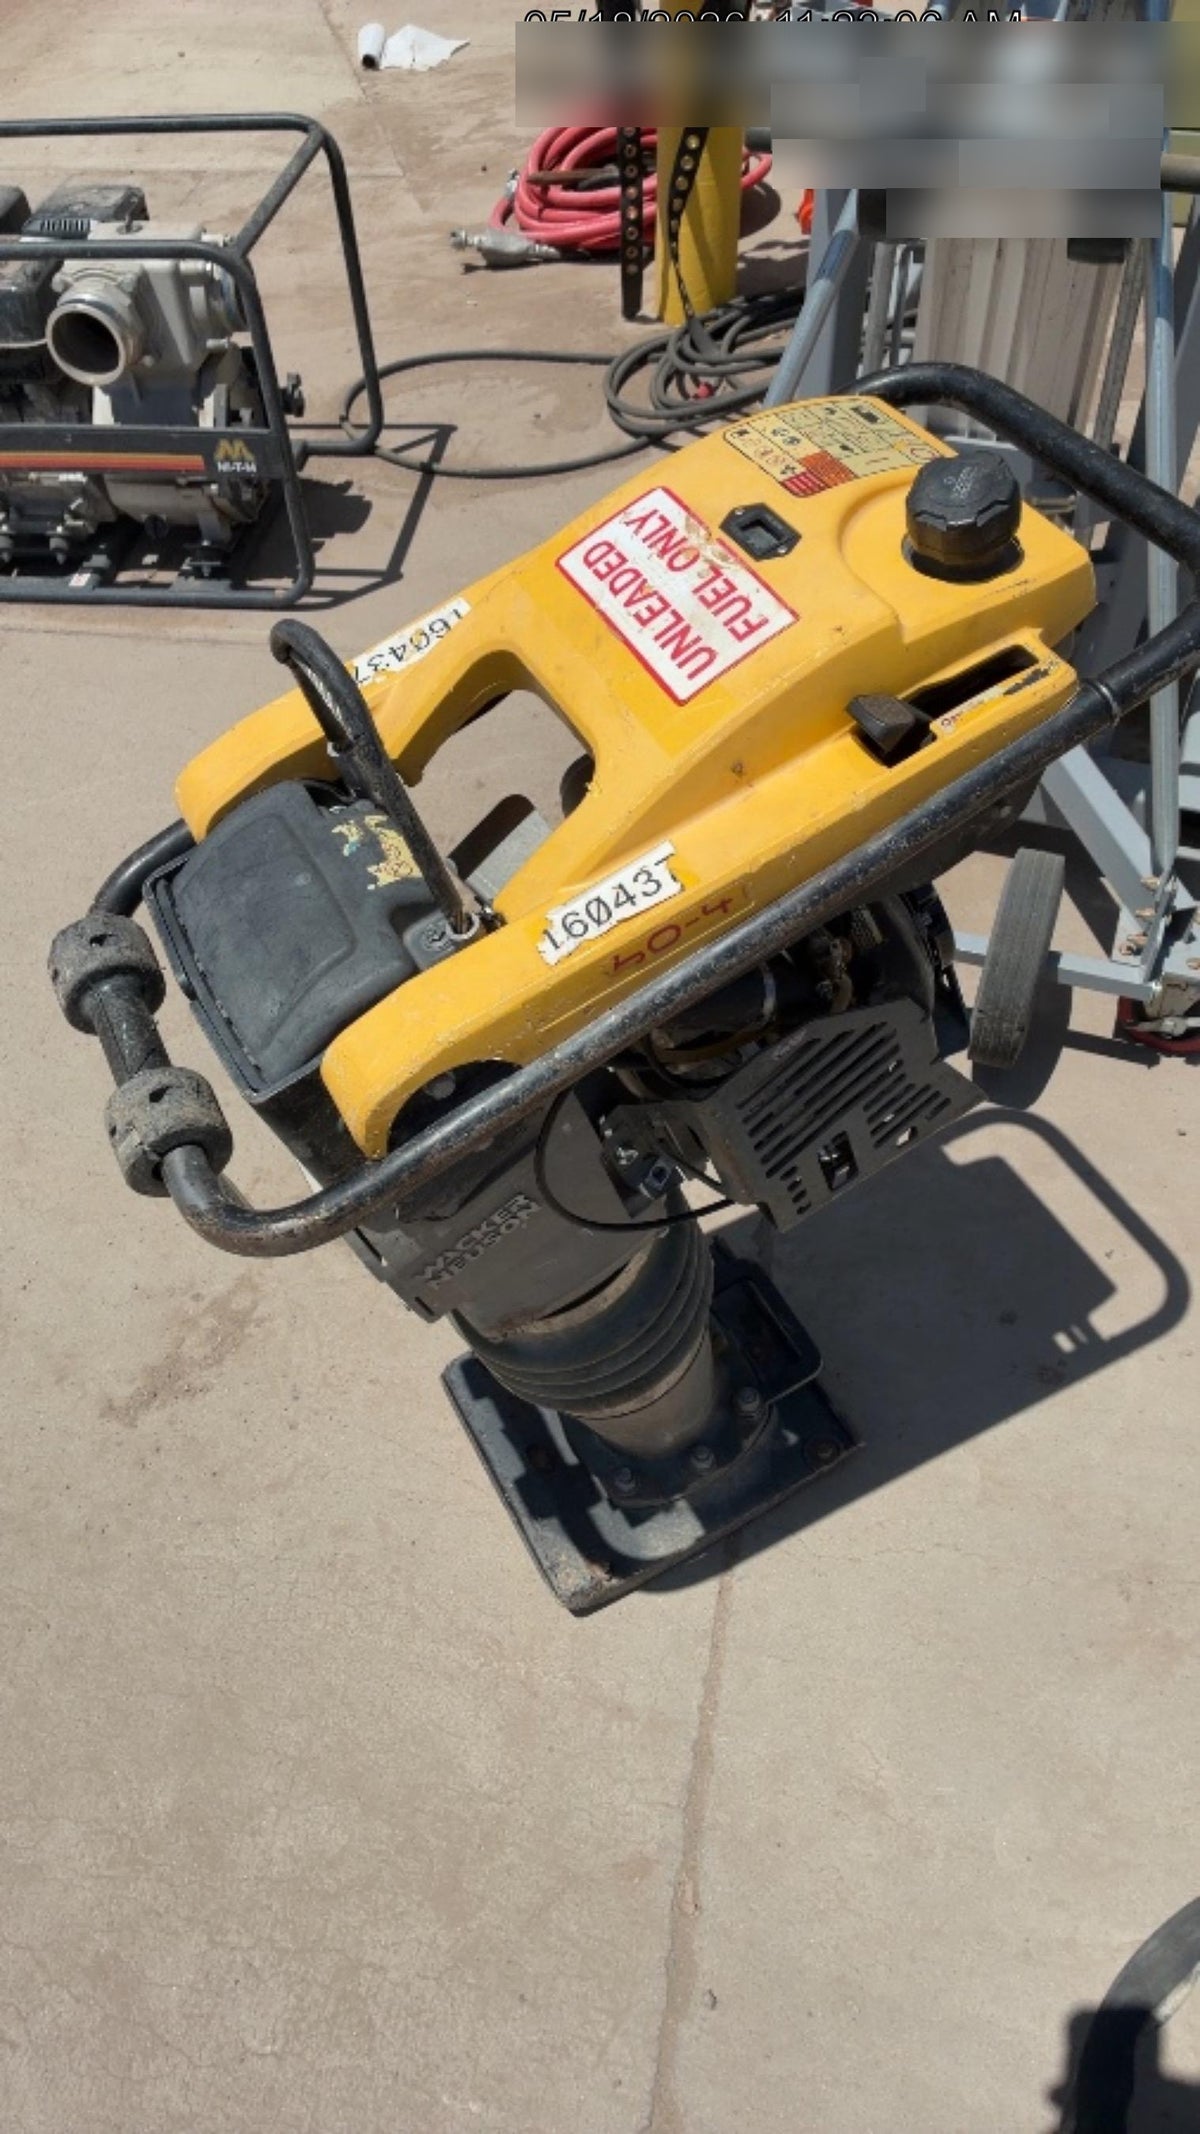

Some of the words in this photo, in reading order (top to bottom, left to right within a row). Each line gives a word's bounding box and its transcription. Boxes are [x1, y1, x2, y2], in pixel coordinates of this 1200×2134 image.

[624, 509, 701, 572] ONLY
[583, 541, 718, 681] UNLEADED
[692, 564, 770, 643] FUEL
